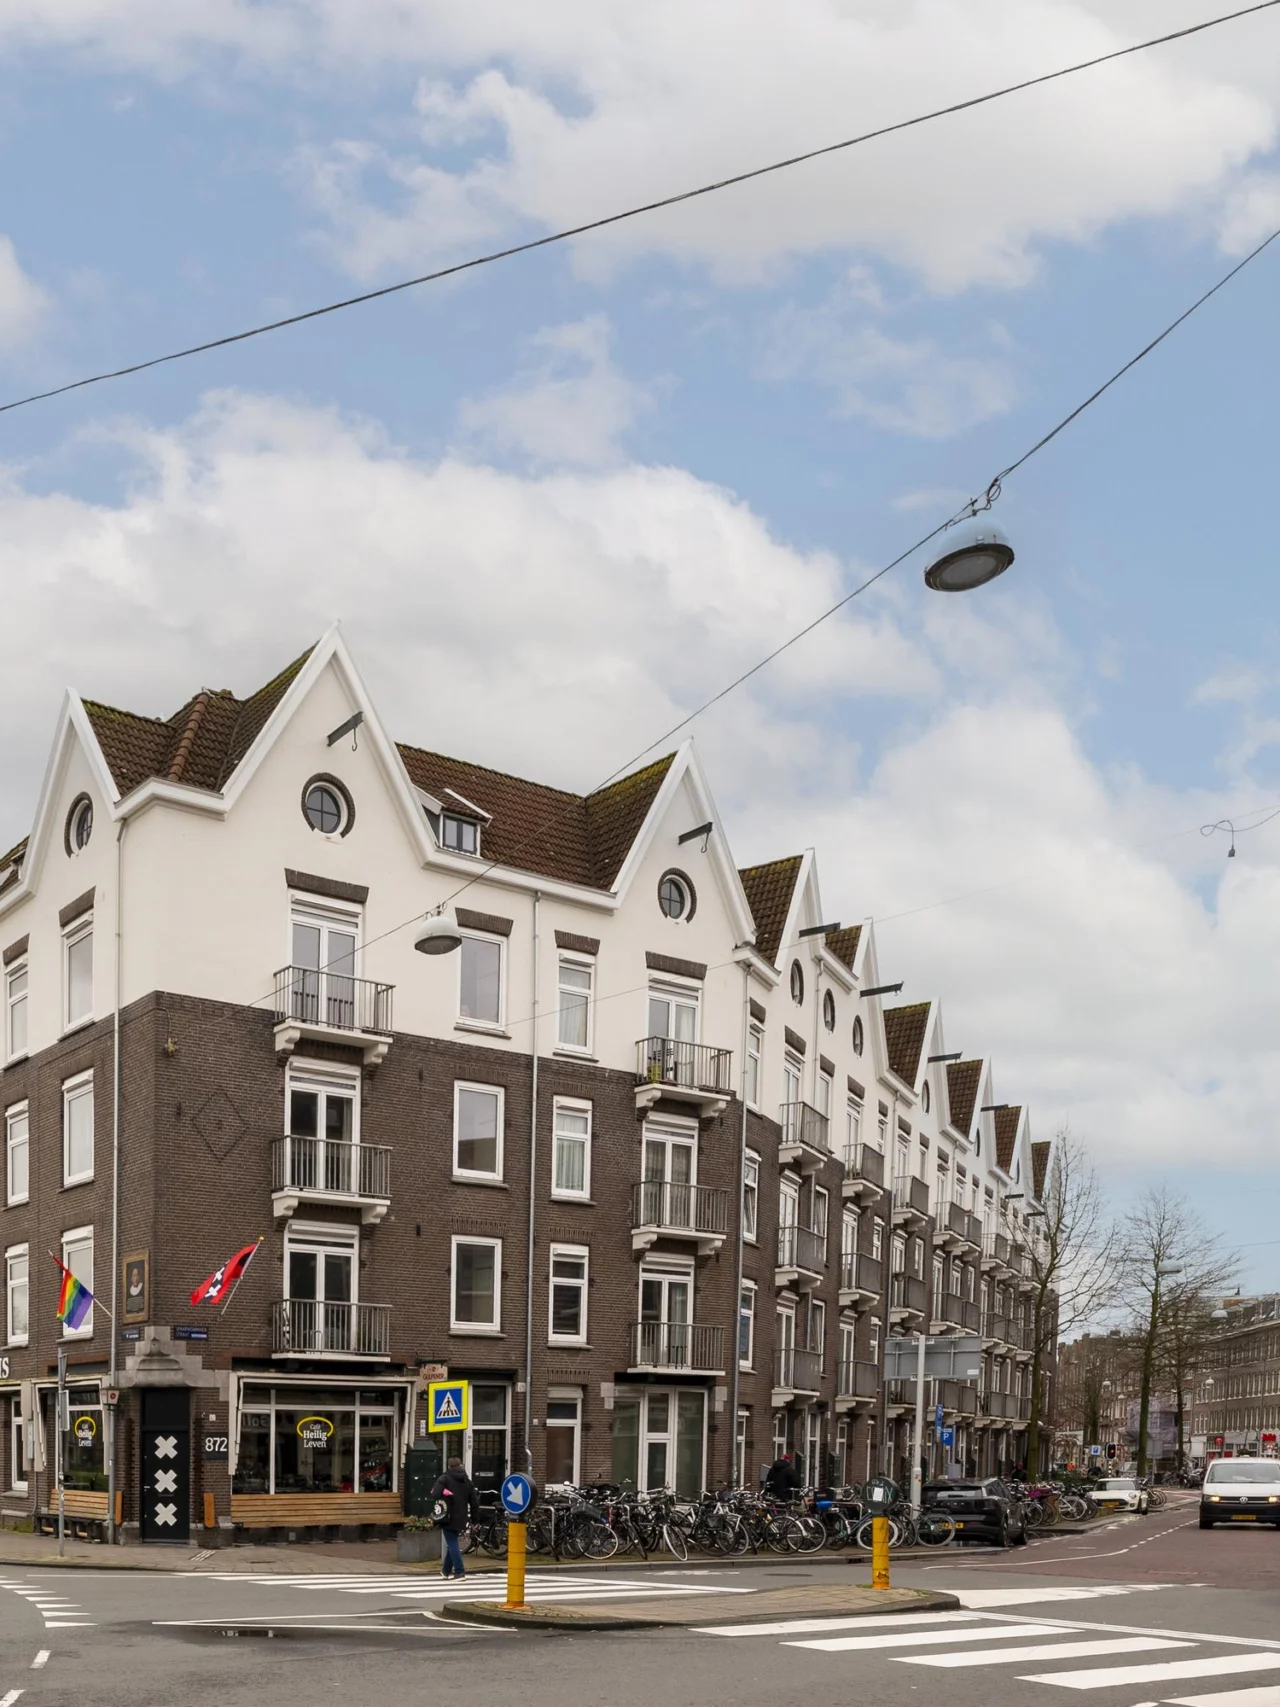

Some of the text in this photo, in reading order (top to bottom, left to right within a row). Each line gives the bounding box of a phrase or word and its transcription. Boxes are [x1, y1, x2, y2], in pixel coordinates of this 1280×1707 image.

[303, 1430, 327, 1441] Heilig
[205, 1437, 228, 1452] 872
[303, 1440, 327, 1448] Leven
